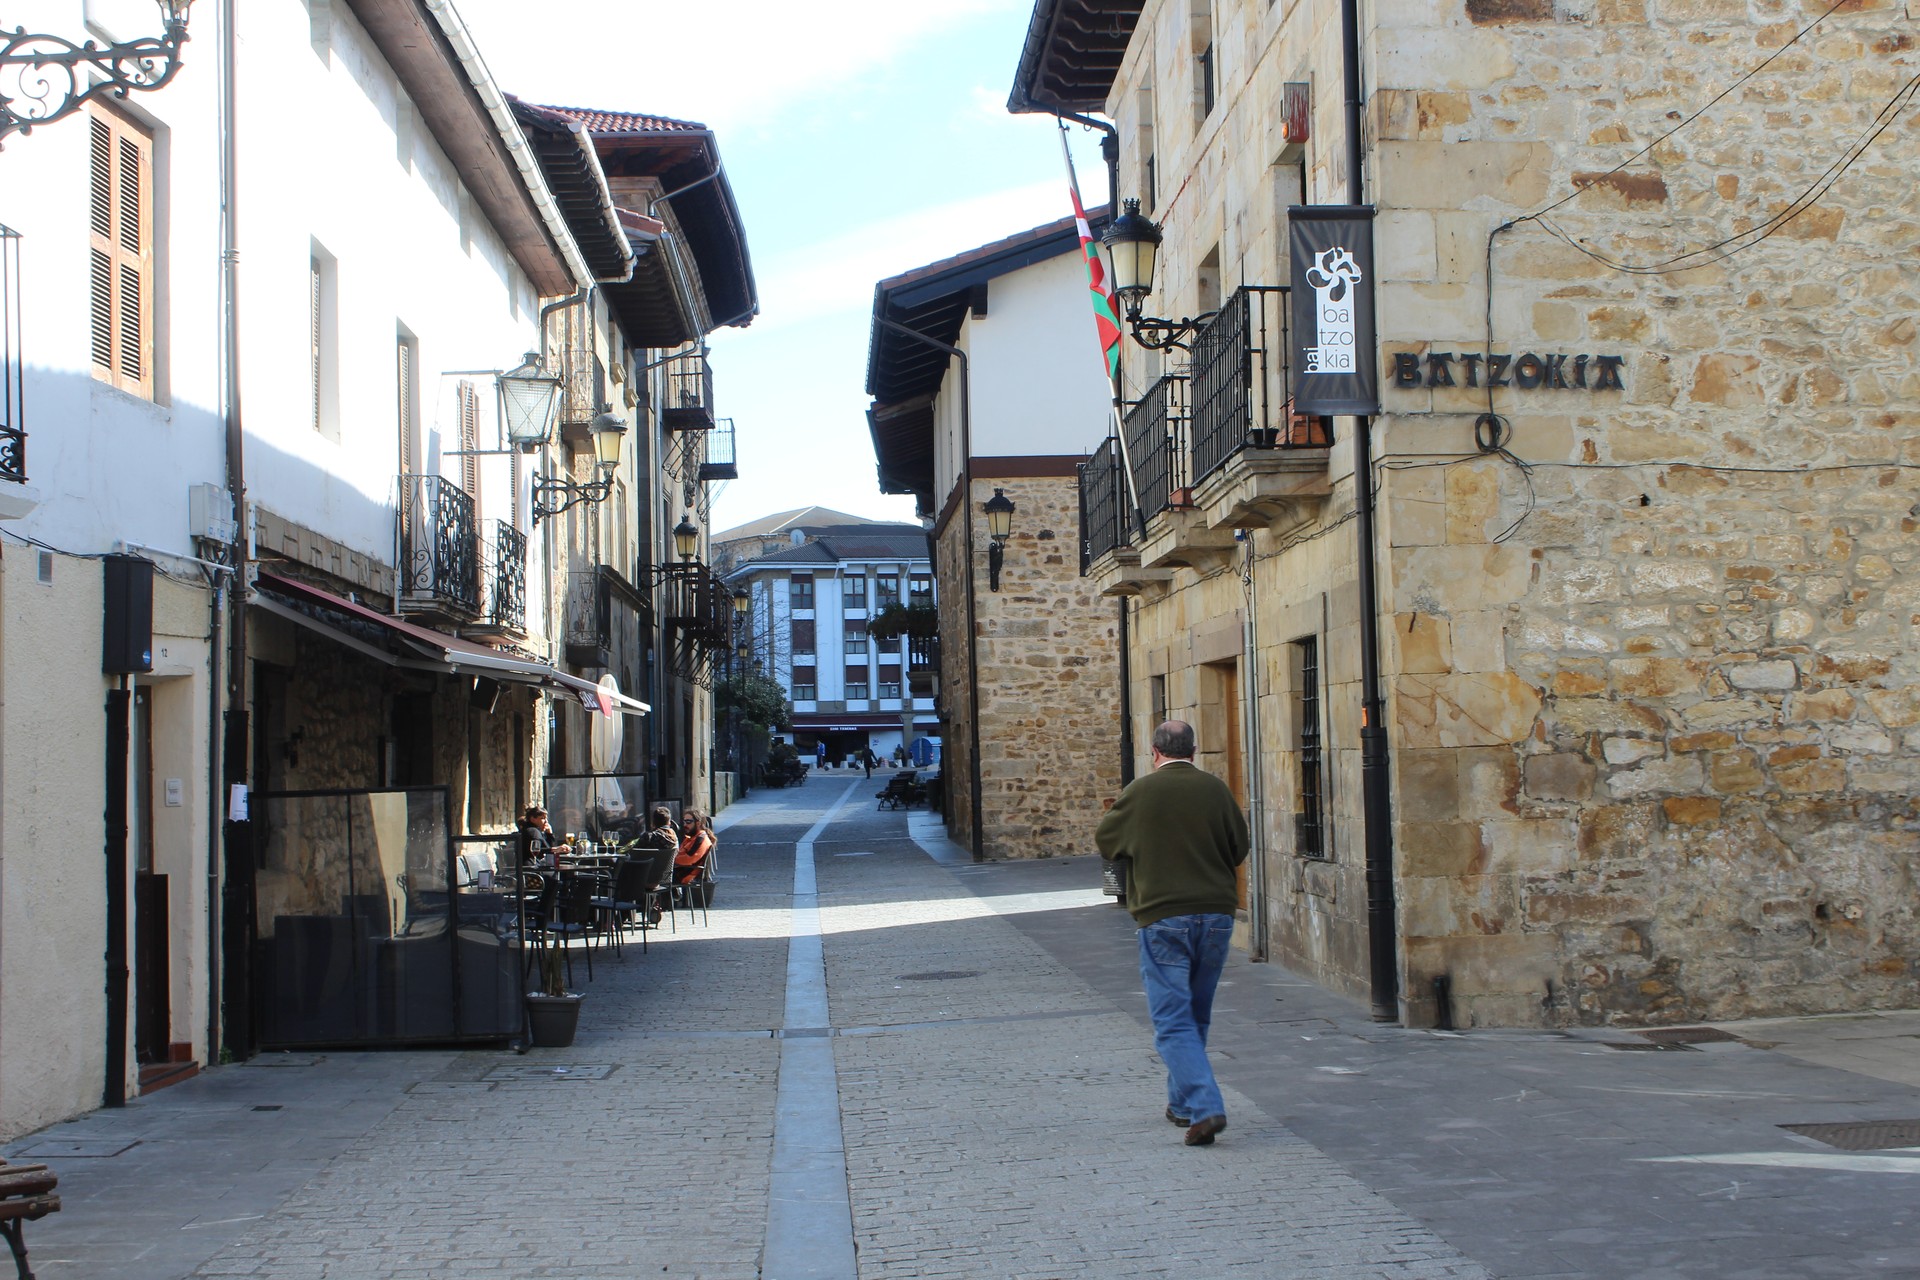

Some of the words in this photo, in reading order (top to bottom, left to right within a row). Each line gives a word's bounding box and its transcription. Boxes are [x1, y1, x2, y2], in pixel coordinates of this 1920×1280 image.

[1322, 303, 1349, 323] ba
[1319, 328, 1354, 346] tzo
[1302, 347, 1319, 374] bai
[1324, 349, 1350, 368] kia
[160, 648, 168, 658] 12
